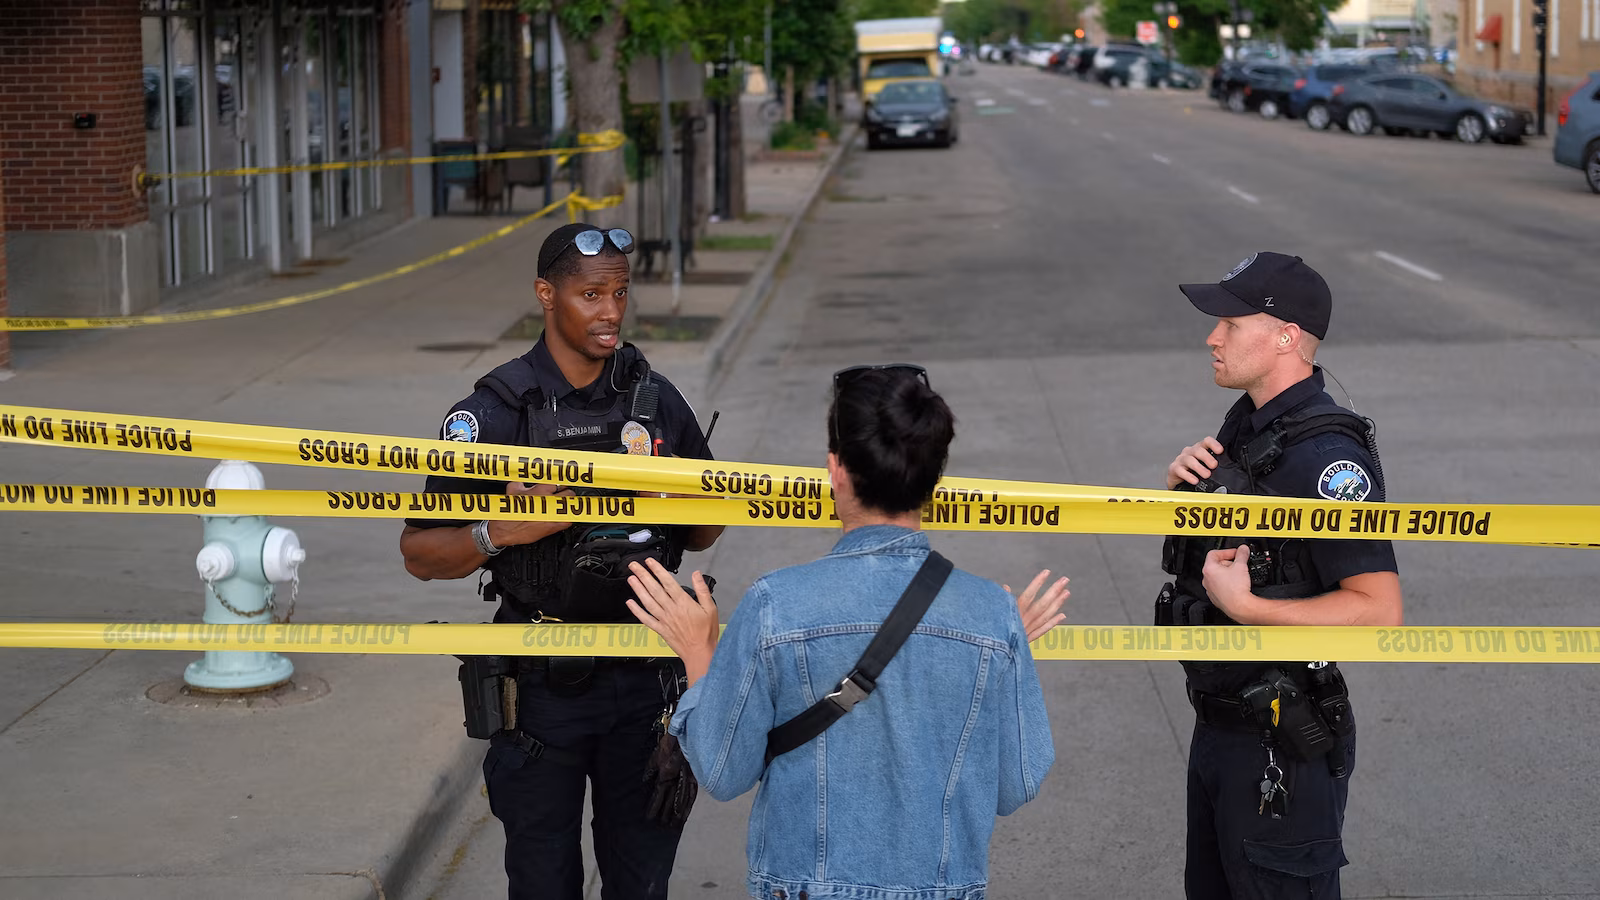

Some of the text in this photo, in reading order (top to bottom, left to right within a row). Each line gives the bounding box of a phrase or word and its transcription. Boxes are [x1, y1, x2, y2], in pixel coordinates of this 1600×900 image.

[24, 415, 54, 441] DO
[61, 419, 109, 445] LINE
[452, 413, 476, 438] BOULDER
[557, 426, 602, 438] S. BENJAMIN
[116, 424, 192, 452] POLICE
[298, 437, 594, 484] POLICE LINE DO NOT CROSS
[1323, 463, 1364, 483] BOULDER
[0, 484, 35, 504] NO
[43, 485, 73, 504] DO
[701, 469, 822, 500] NOT CROSS
[138, 487, 216, 507] POLICE
[327, 491, 401, 511] CROSS
[409, 492, 452, 512] NOT
[461, 493, 490, 513] DO
[556, 496, 635, 517] POLICE
[748, 500, 822, 521] CROSS
[921, 503, 1061, 526] POLICE LINE
[1174, 506, 1491, 536] POLICE LINE DO NOT CROSS
